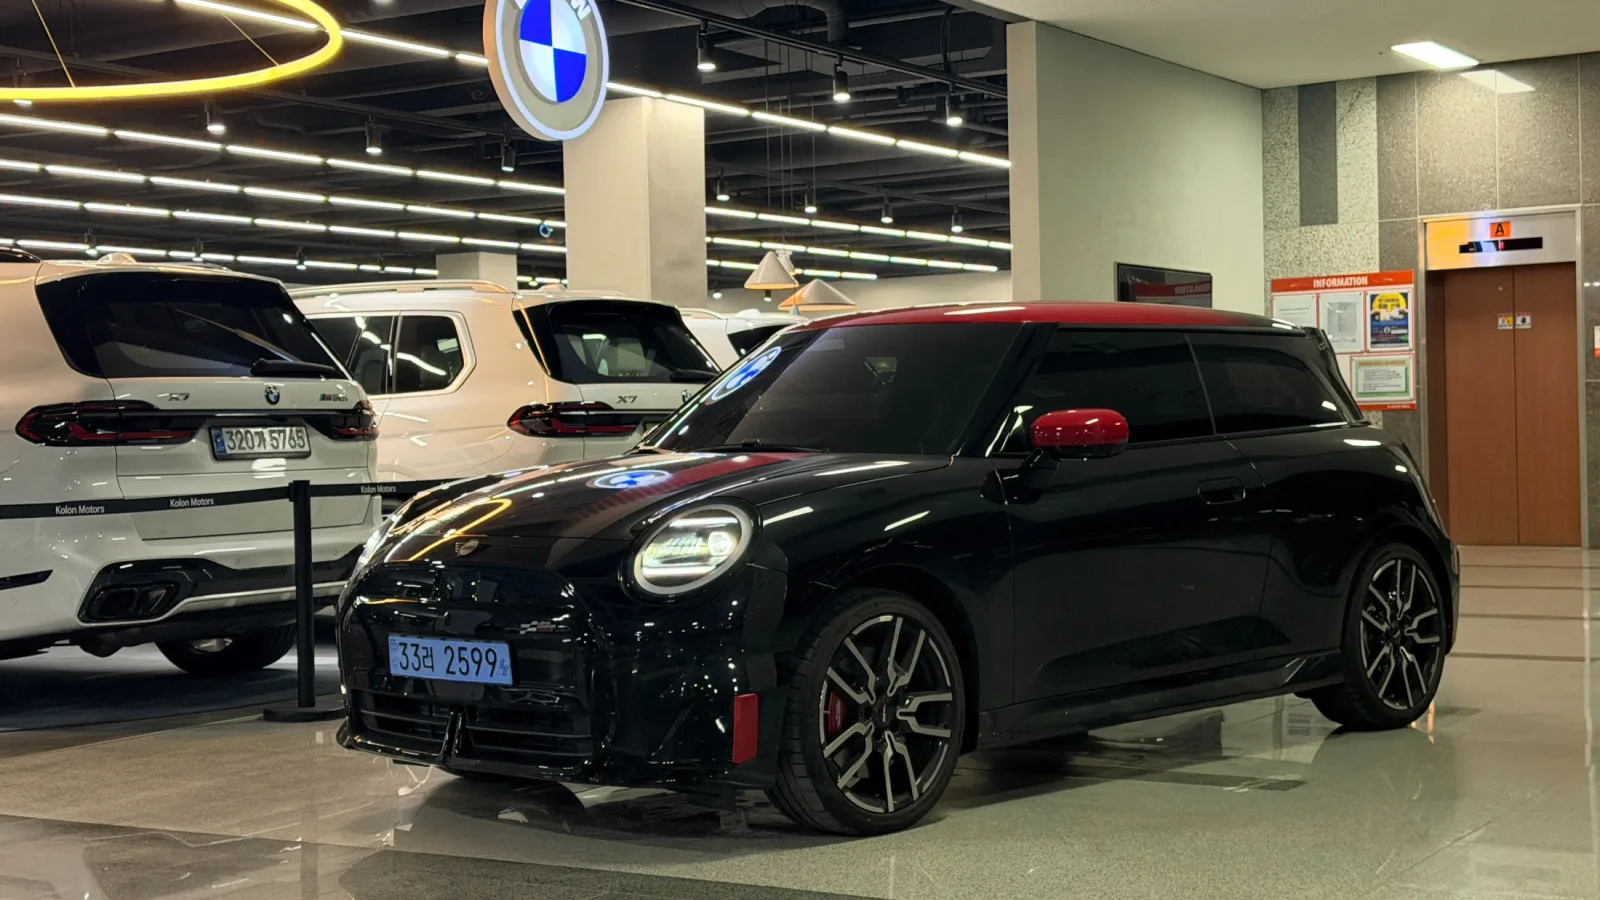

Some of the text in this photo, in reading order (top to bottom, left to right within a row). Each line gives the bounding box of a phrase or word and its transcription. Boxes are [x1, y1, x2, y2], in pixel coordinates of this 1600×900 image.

[1495, 222, 1505, 236] A
[1313, 275, 1369, 289] INFORMATION
[616, 395, 638, 404] X7
[225, 427, 306, 450] 320가 5765
[361, 485, 396, 494] Kolon Motors
[170, 497, 215, 508] Kolon Motors
[55, 504, 105, 515] Kolon Motors
[398, 642, 498, 678] 33러 2599
